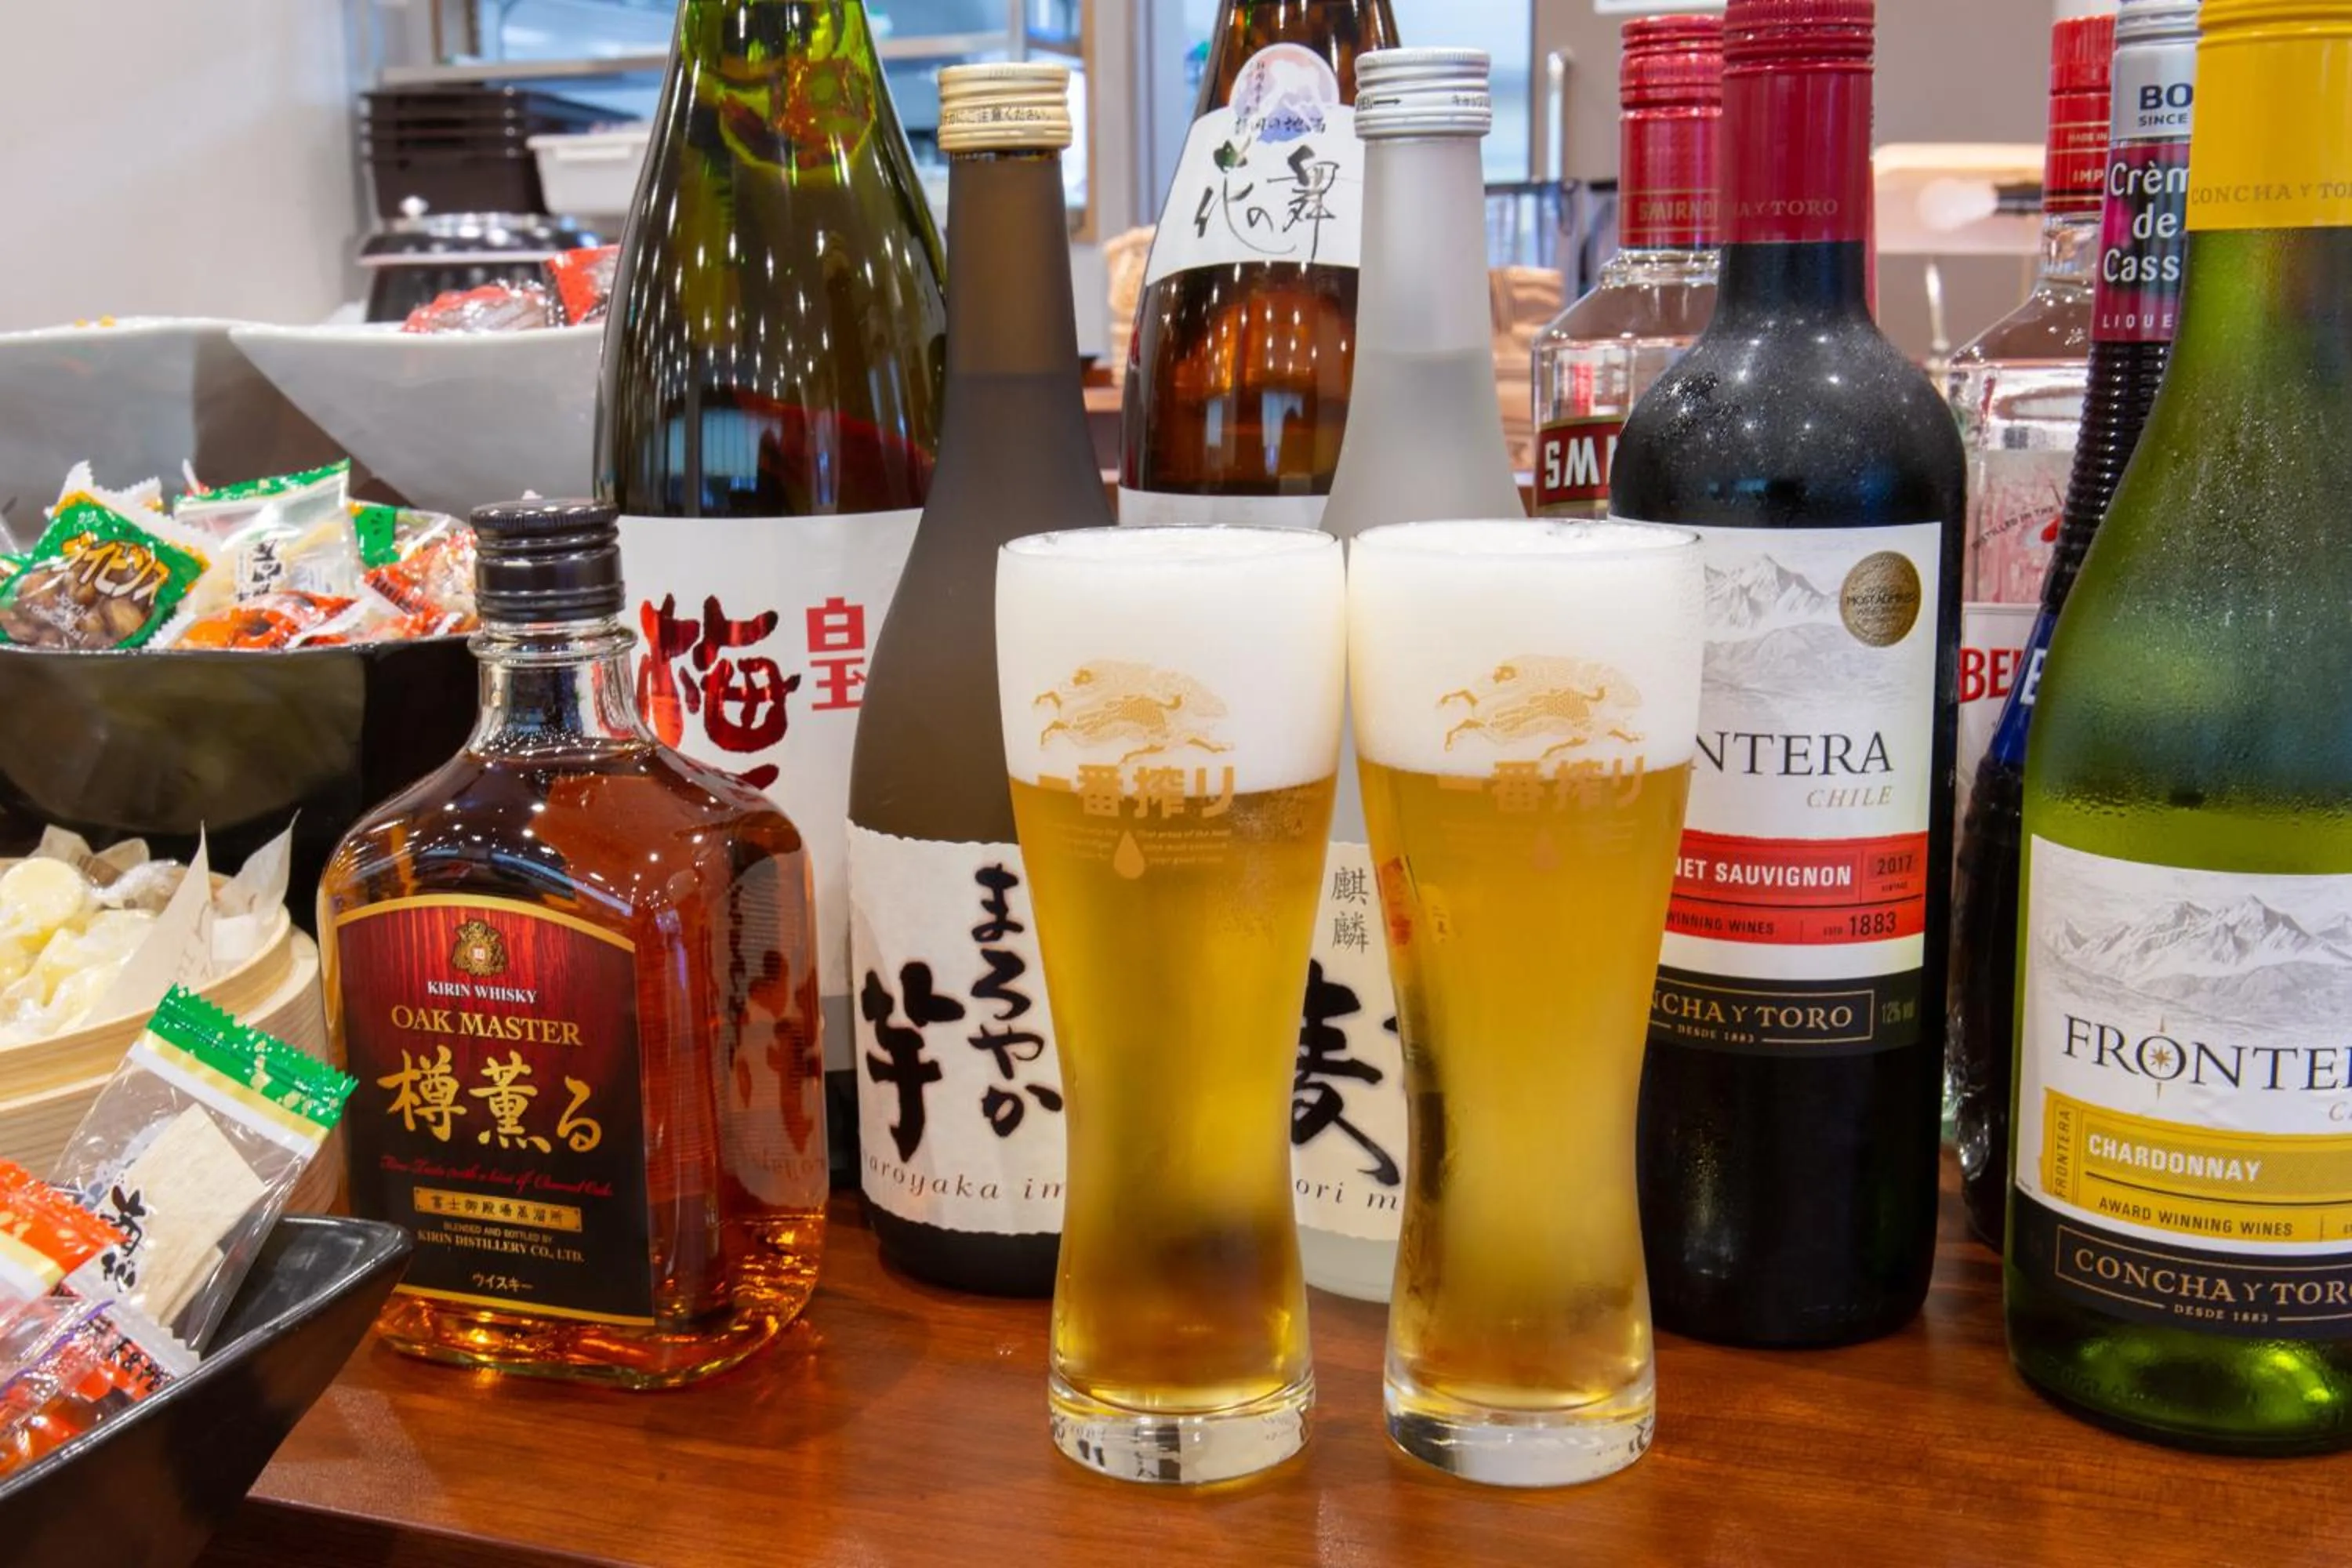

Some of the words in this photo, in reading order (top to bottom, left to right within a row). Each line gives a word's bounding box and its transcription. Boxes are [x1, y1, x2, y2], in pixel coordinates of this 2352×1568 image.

[2140, 83, 2194, 111] BO
[2139, 113, 2187, 126] SINCE
[2073, 169, 2104, 183] IMP
[2110, 159, 2191, 197] Crèm
[1770, 198, 1839, 217] TORO
[2191, 183, 2292, 205] CONCHA
[1639, 199, 1719, 222] SMIRNO
[2132, 202, 2177, 239] de
[2103, 248, 2181, 282] Cass
[2103, 314, 2174, 329] LIQUE
[637, 592, 801, 790] 梅
[1696, 730, 1894, 776] NTERA
[1038, 764, 1234, 818] 一番搾り
[1438, 756, 1644, 813] 一番搾り
[1806, 785, 1893, 809] CHILE
[1715, 862, 1851, 887] SAUVIGNON
[1877, 854, 1913, 876] 2017
[1331, 866, 1370, 953] 麒麟
[1667, 910, 1723, 931] WINNING
[1729, 919, 1775, 935] WINES
[1849, 911, 1896, 937] 1883
[427, 979, 470, 996] KIRIN
[474, 982, 538, 1004] WHISKY
[968, 862, 1064, 1138] まろやか
[392, 1004, 455, 1034] OAK
[459, 1012, 584, 1047] MASTER
[1678, 1023, 1717, 1040] DESDE
[1731, 1004, 1748, 1023] Y
[1755, 1006, 1853, 1031] TORO
[862, 960, 966, 1163] 芋
[2063, 1013, 2352, 1092] FRONTE
[377, 1044, 602, 1153] 樽薫る
[2053, 1108, 2072, 1199] FRONTERA
[2088, 1134, 2263, 1182] CHARDONNAY
[1296, 1178, 1344, 1203] ori
[2099, 1196, 2152, 1221] AWARD
[2158, 1209, 2233, 1233] WINNING
[2240, 1221, 2294, 1237] WINES
[417, 1229, 452, 1244] KIRIN
[455, 1234, 527, 1254] DISTILLERY
[556, 1247, 585, 1262] LTD.
[484, 1225, 501, 1236] AND
[504, 1228, 539, 1240] BOTTLED
[472, 1273, 534, 1292] ウイスキー
[2075, 1248, 2237, 1304] CONCHA
[2242, 1282, 2264, 1302] Y
[2270, 1280, 2352, 1305] TOR
[2174, 1304, 2225, 1320] DESDE
